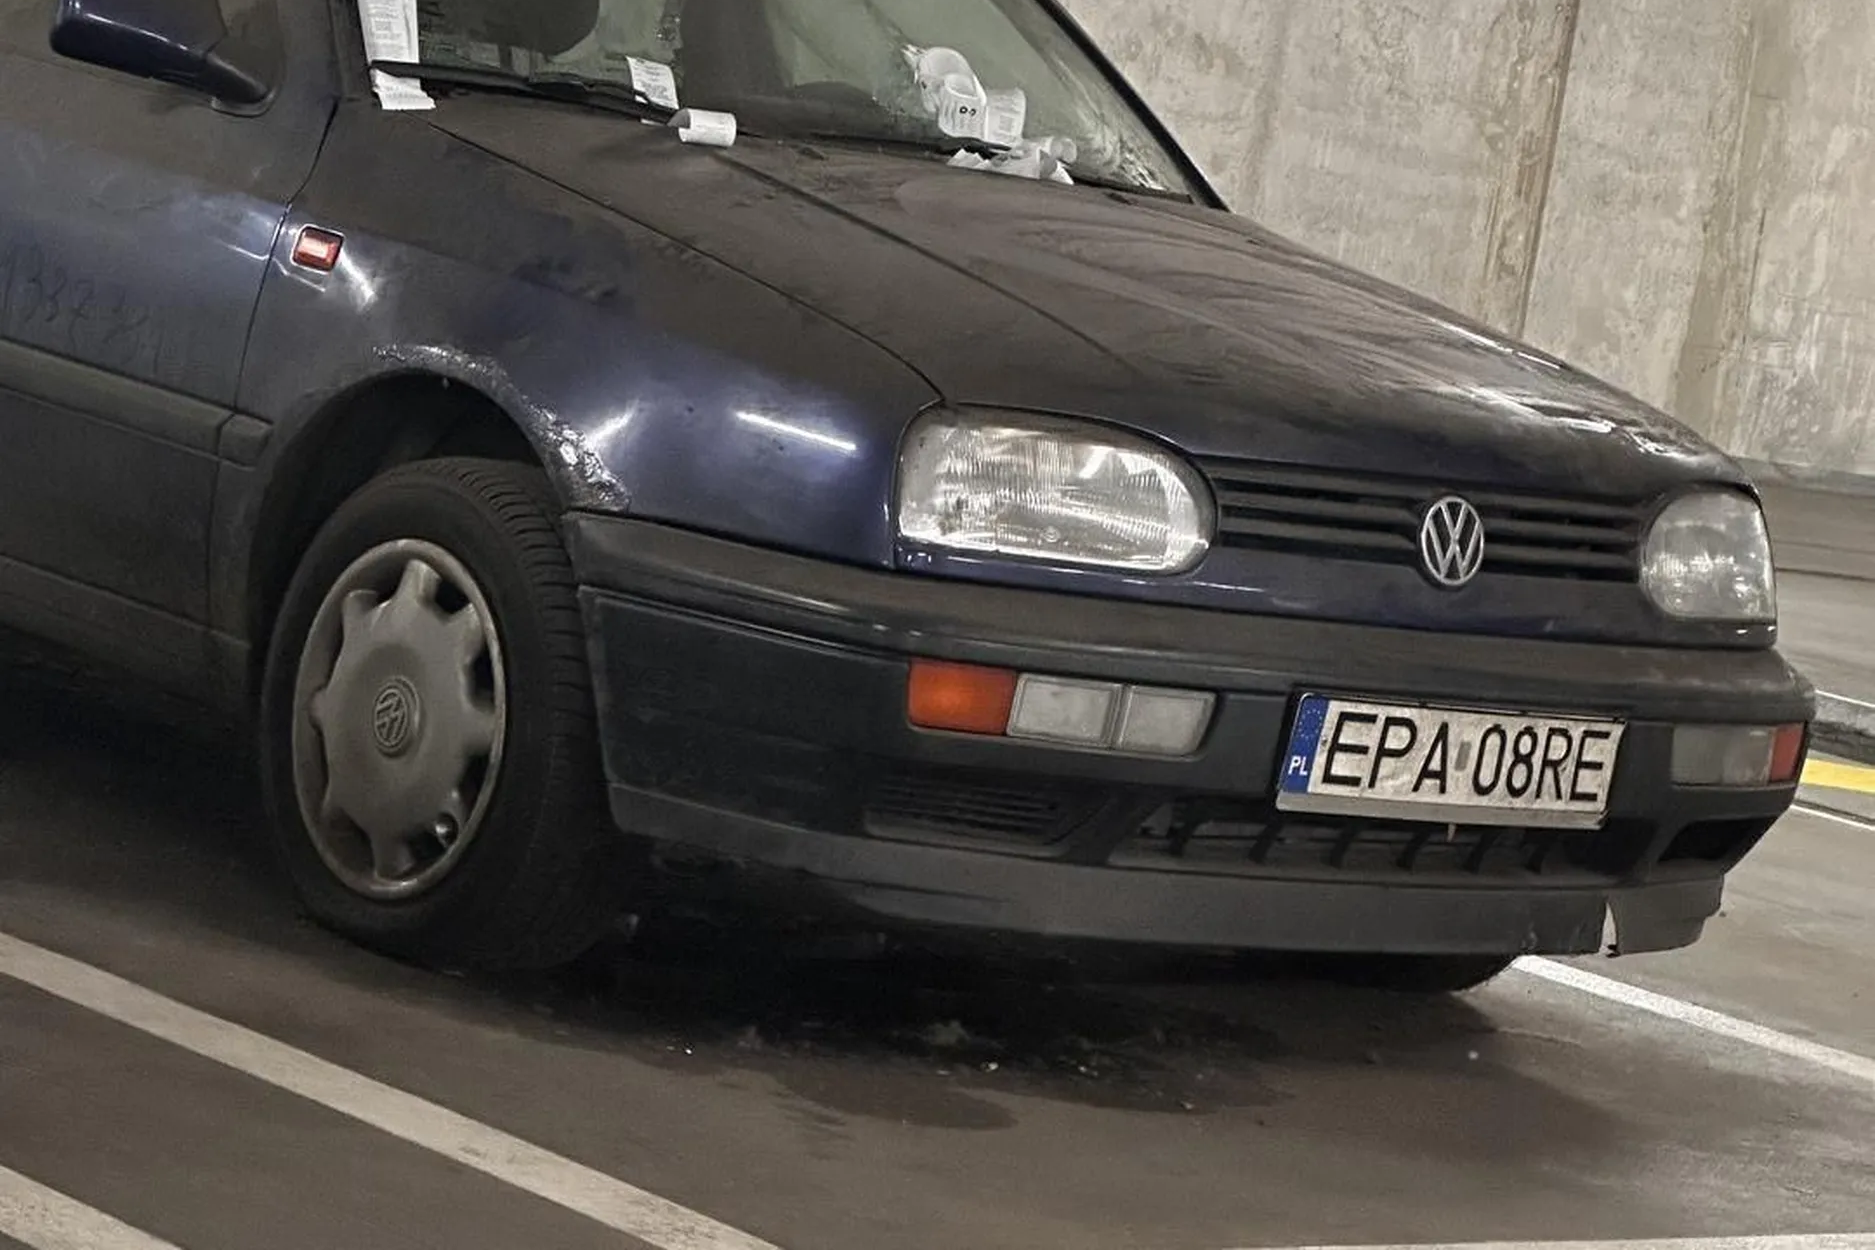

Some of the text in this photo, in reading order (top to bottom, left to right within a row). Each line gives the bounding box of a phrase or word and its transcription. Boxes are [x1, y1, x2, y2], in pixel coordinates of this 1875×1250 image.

[1287, 757, 1308, 777] PL
[1321, 711, 1612, 802] EPA 08RE
